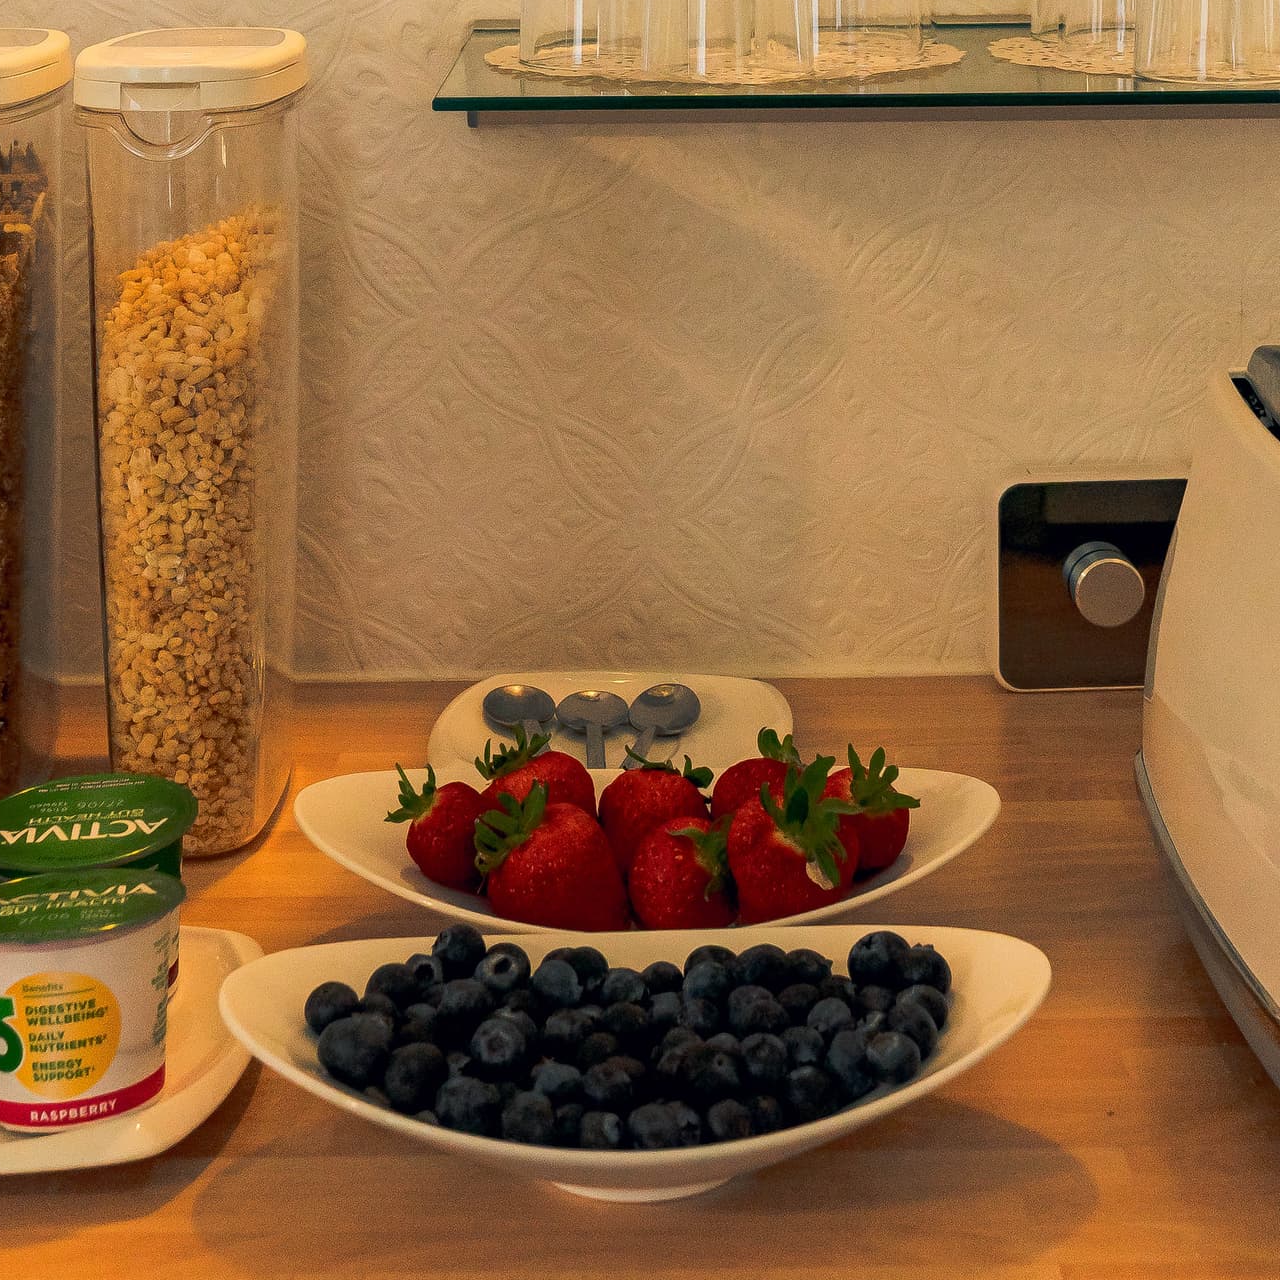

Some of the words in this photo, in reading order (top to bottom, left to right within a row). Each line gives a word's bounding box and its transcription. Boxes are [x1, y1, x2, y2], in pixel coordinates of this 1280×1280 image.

[0, 818, 168, 844] ACTIVIA
[22, 983, 64, 993] Benefits
[25, 998, 97, 1016] DIGESTIVE
[28, 1031, 65, 1042] DAILY
[32, 1058, 82, 1071] ENERGY
[30, 1099, 117, 1122] RASPBERRY
